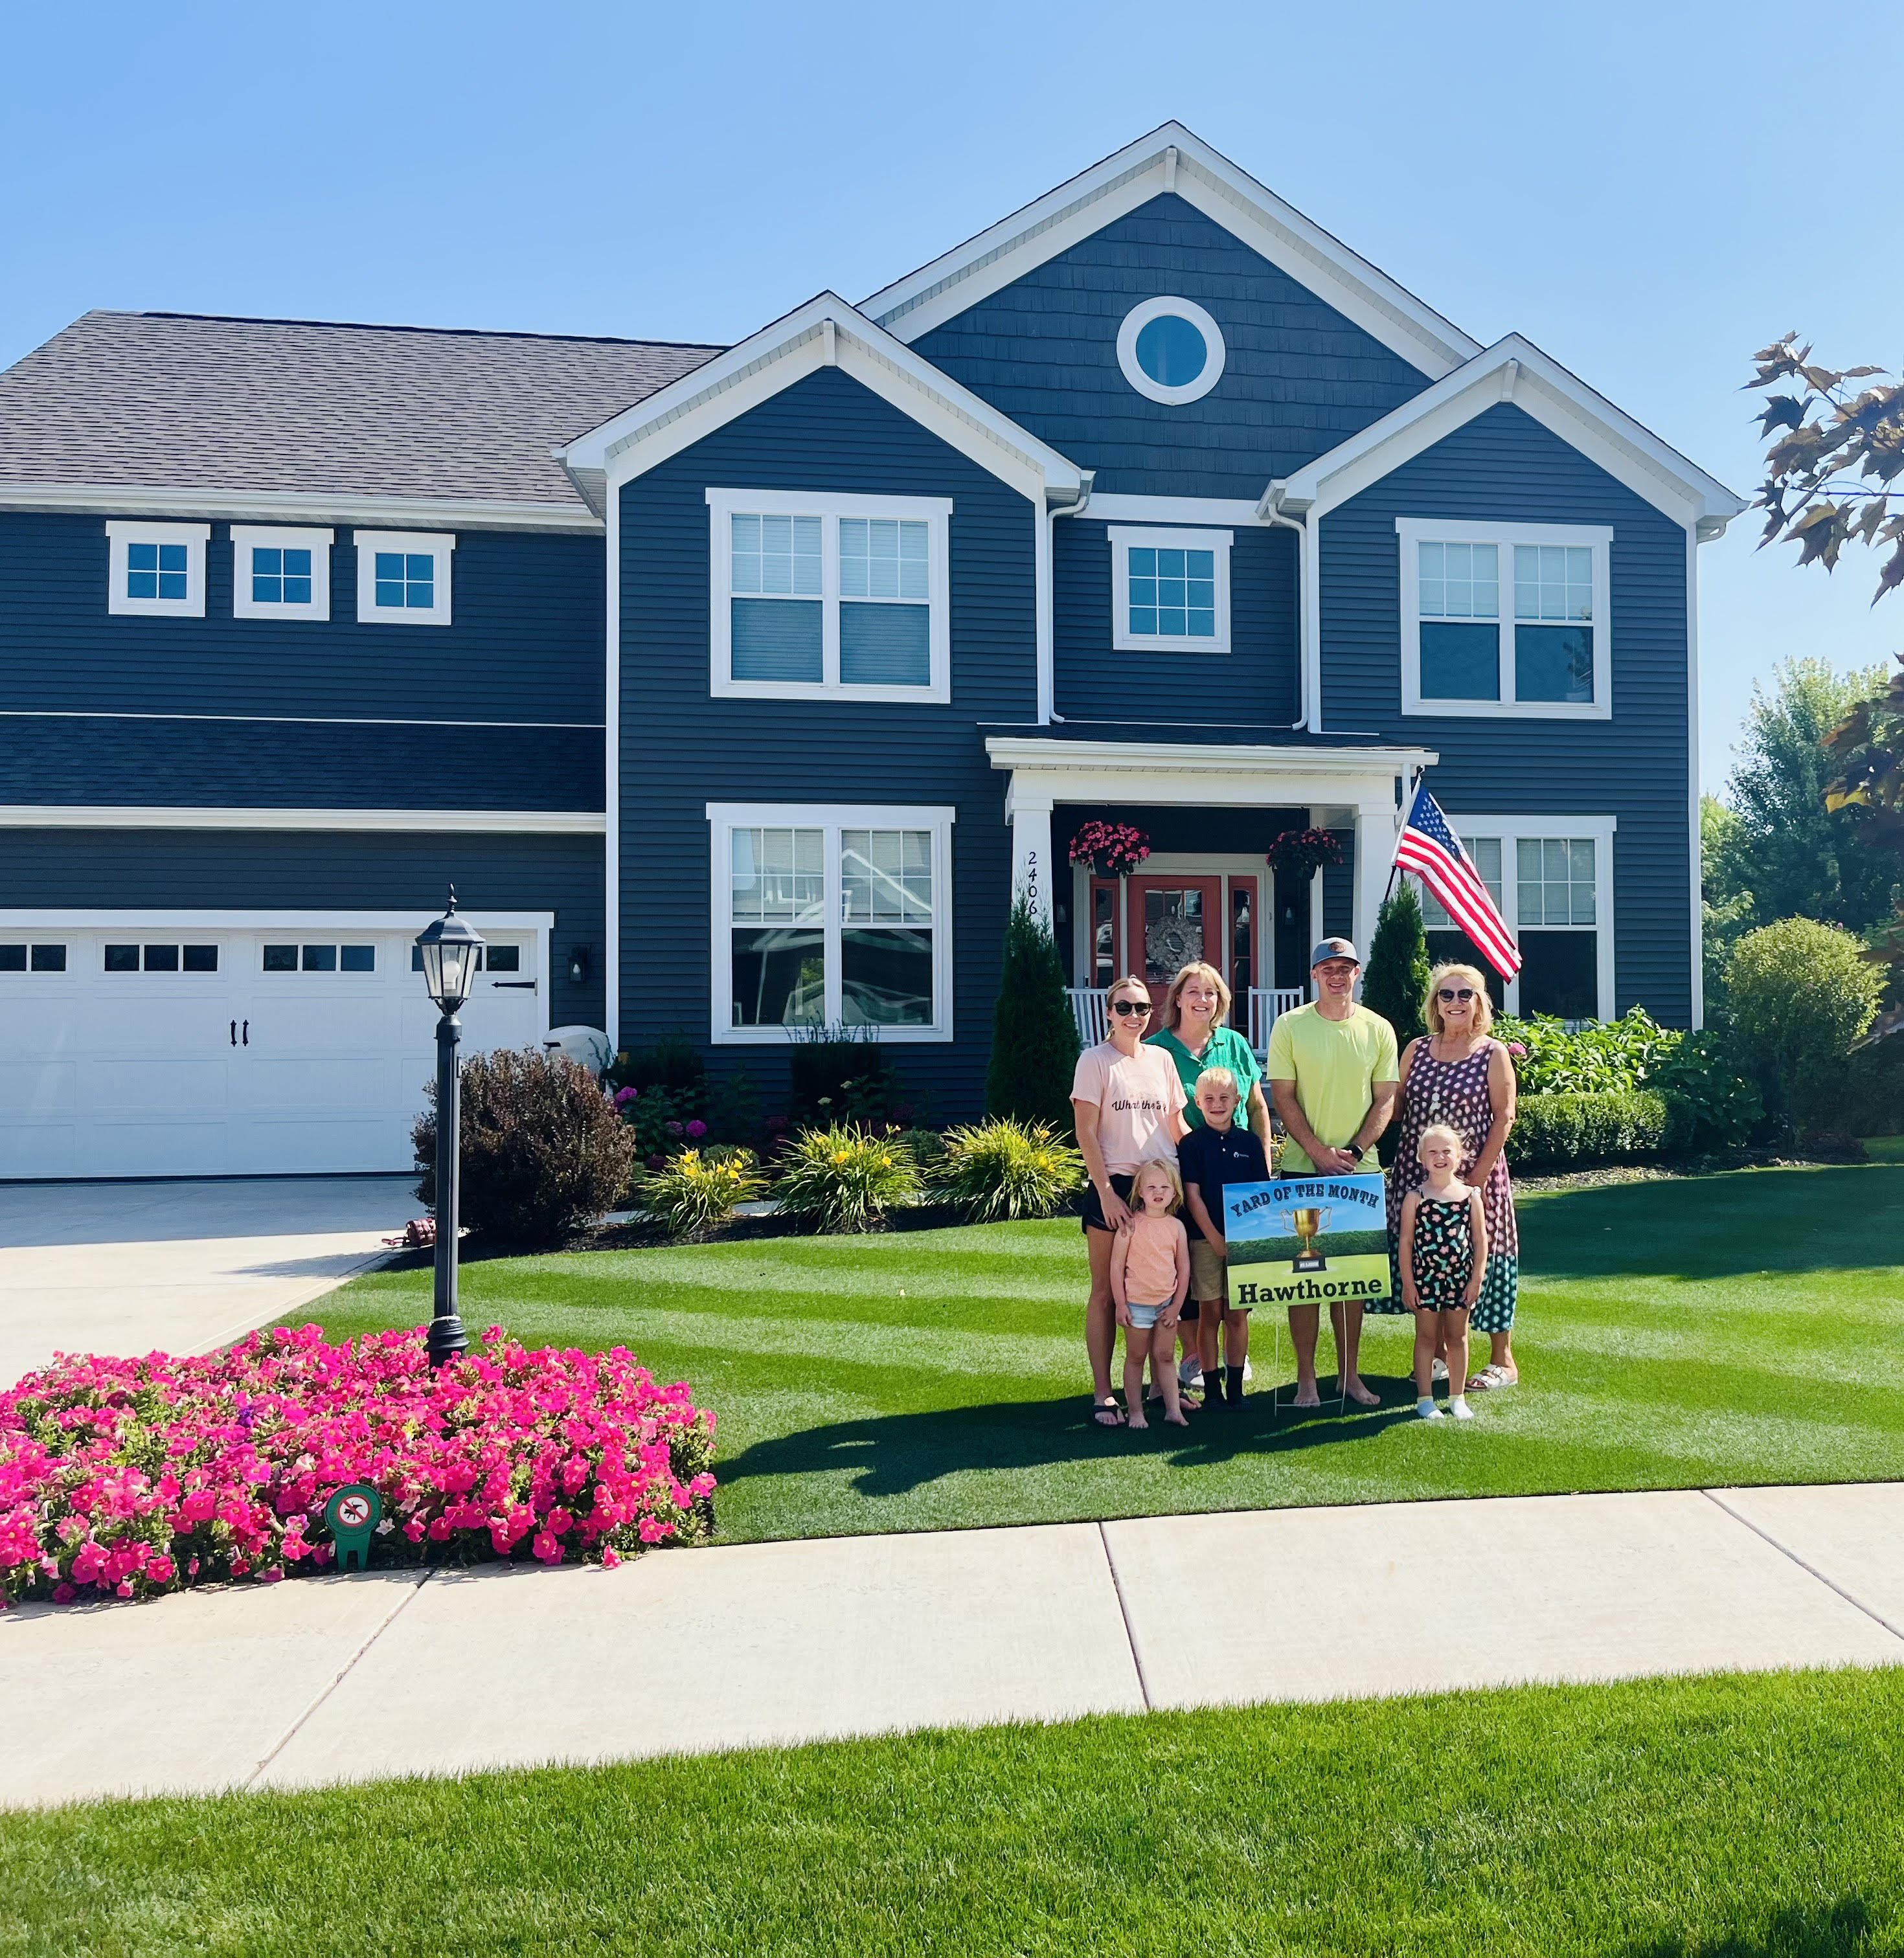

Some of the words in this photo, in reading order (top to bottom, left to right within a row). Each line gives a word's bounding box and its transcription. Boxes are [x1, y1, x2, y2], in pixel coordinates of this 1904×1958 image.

[1028, 851, 1037, 914] 2406
[1230, 1193, 1271, 1217] YARD
[1274, 1186, 1291, 1202] OF
[1295, 1184, 1324, 1198] THE
[1328, 1184, 1379, 1208] MONTH
[1238, 1279, 1382, 1305] Hawthorne
